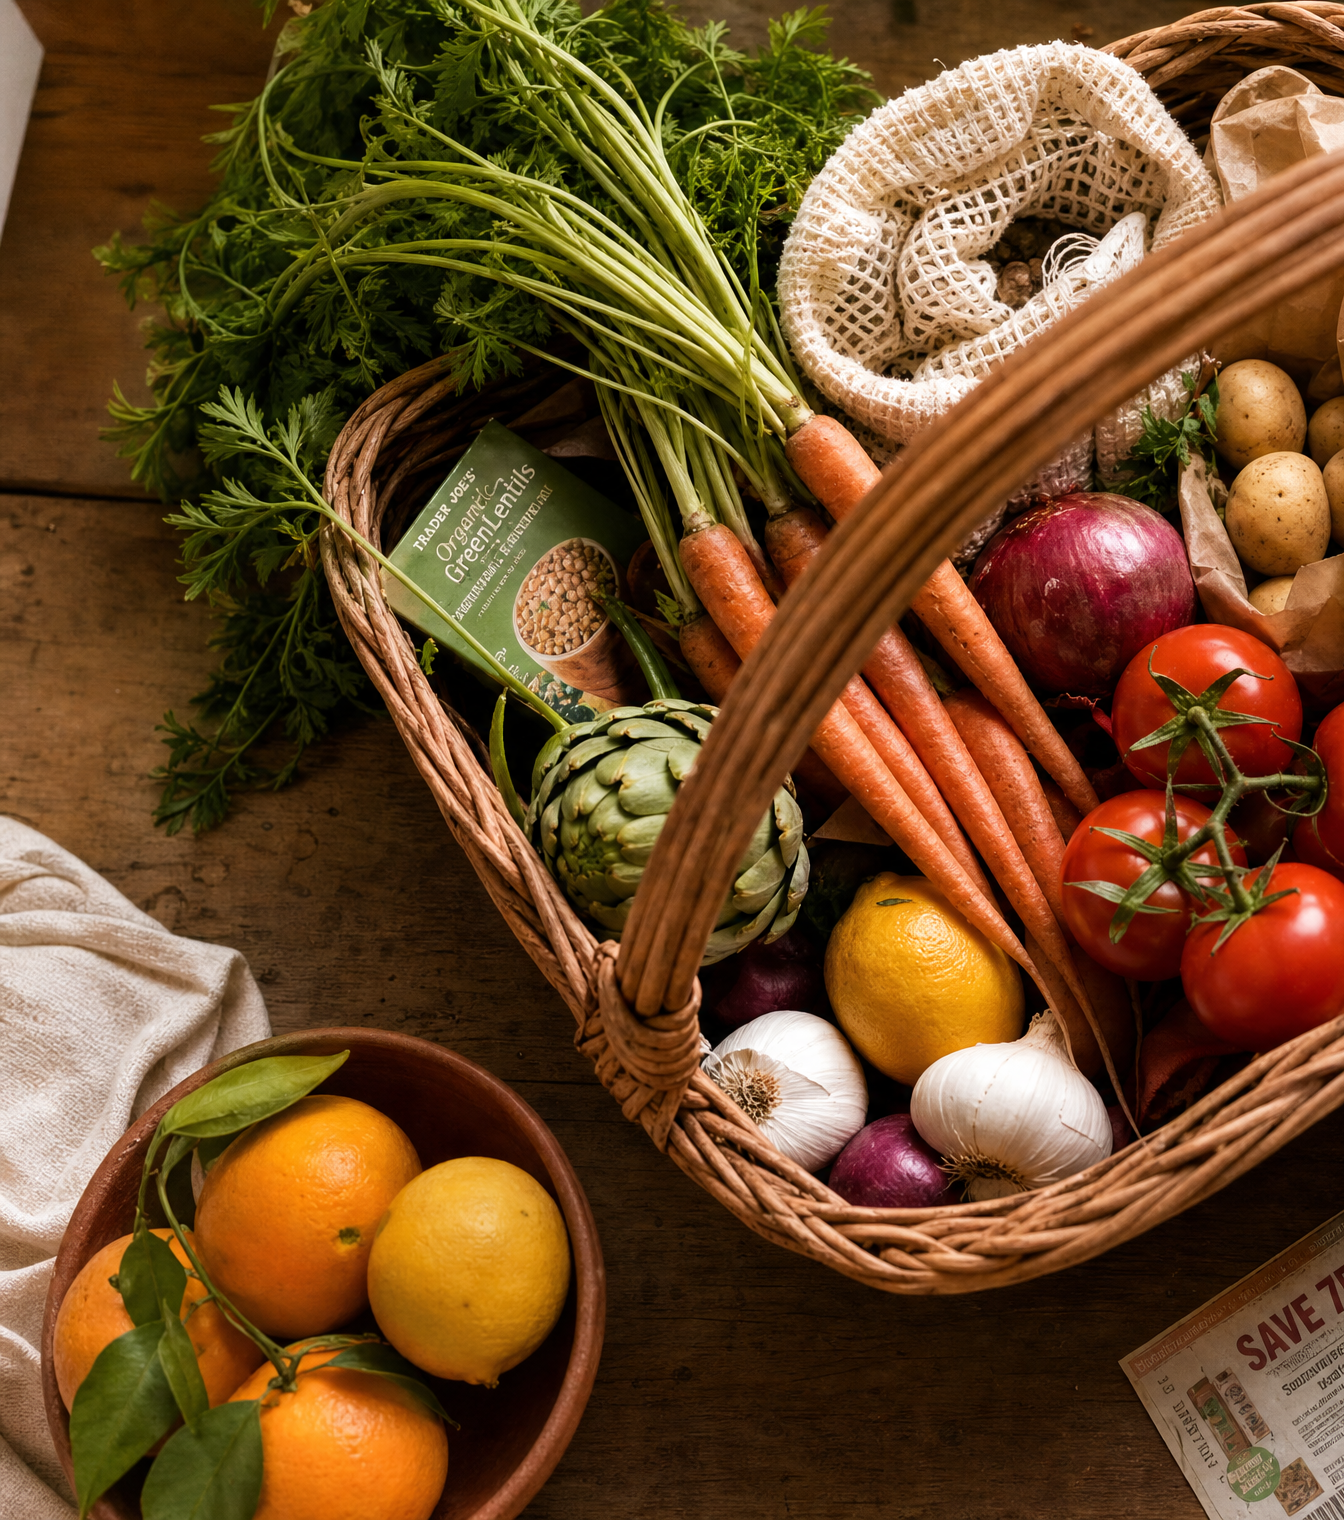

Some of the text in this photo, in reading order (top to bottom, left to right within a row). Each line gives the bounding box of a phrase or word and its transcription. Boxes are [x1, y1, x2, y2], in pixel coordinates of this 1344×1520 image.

[413, 468, 476, 552] TRADER JOE'S
[1236, 1293, 1326, 1371] SAVE
